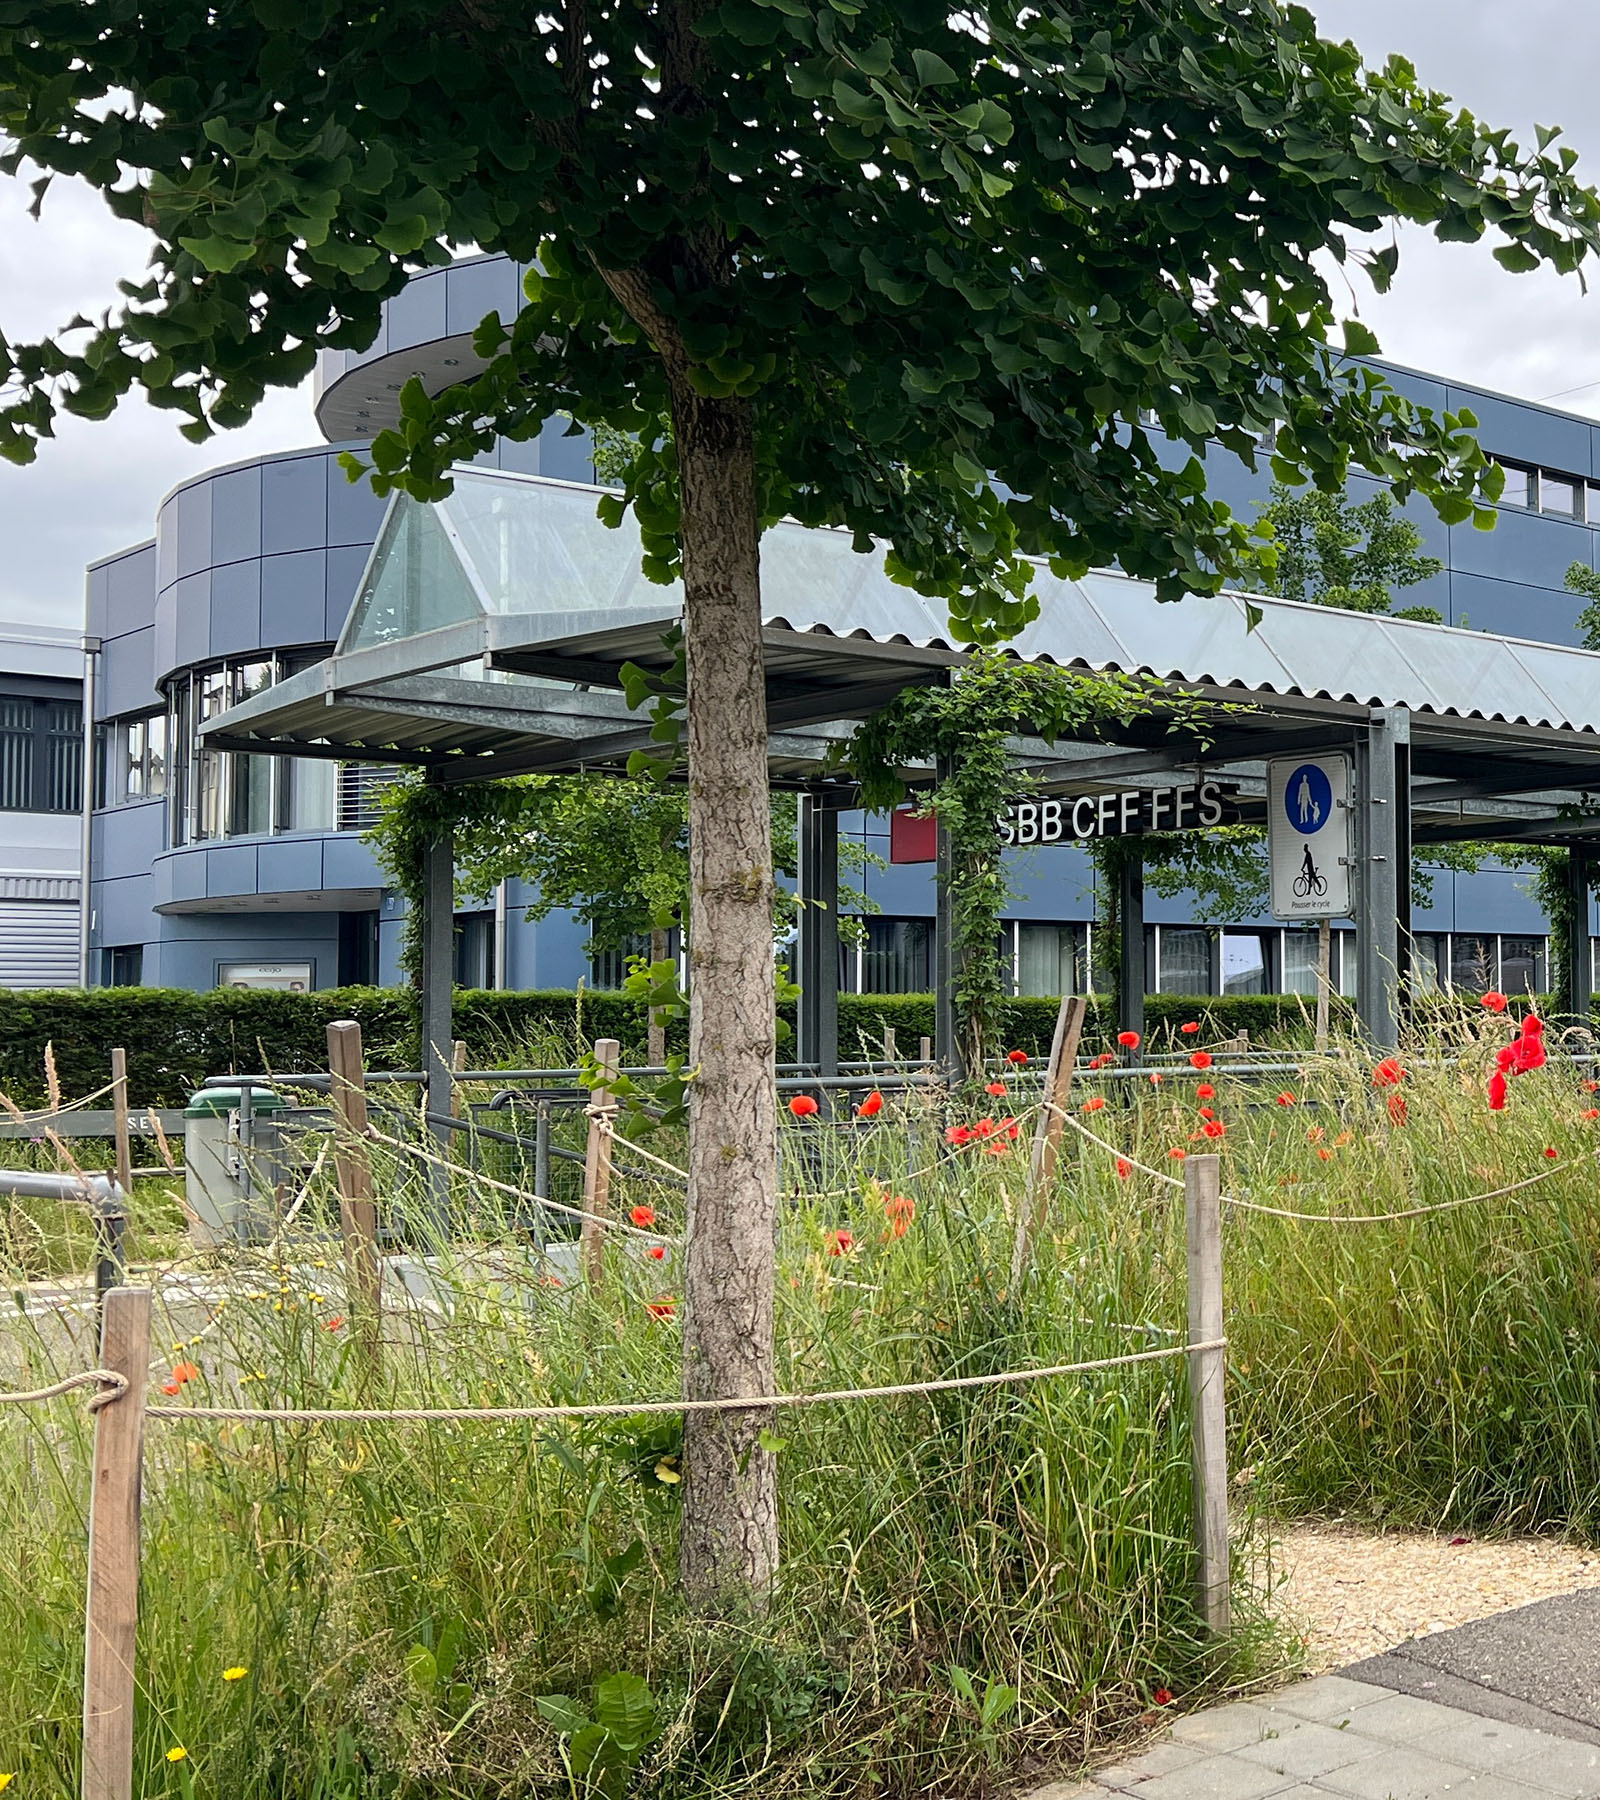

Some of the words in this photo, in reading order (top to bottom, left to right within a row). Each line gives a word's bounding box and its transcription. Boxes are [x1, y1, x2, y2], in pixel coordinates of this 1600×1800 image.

[996, 800, 1063, 844] SBB
[1072, 791, 1140, 838] CFF
[1152, 781, 1222, 830] FFS
